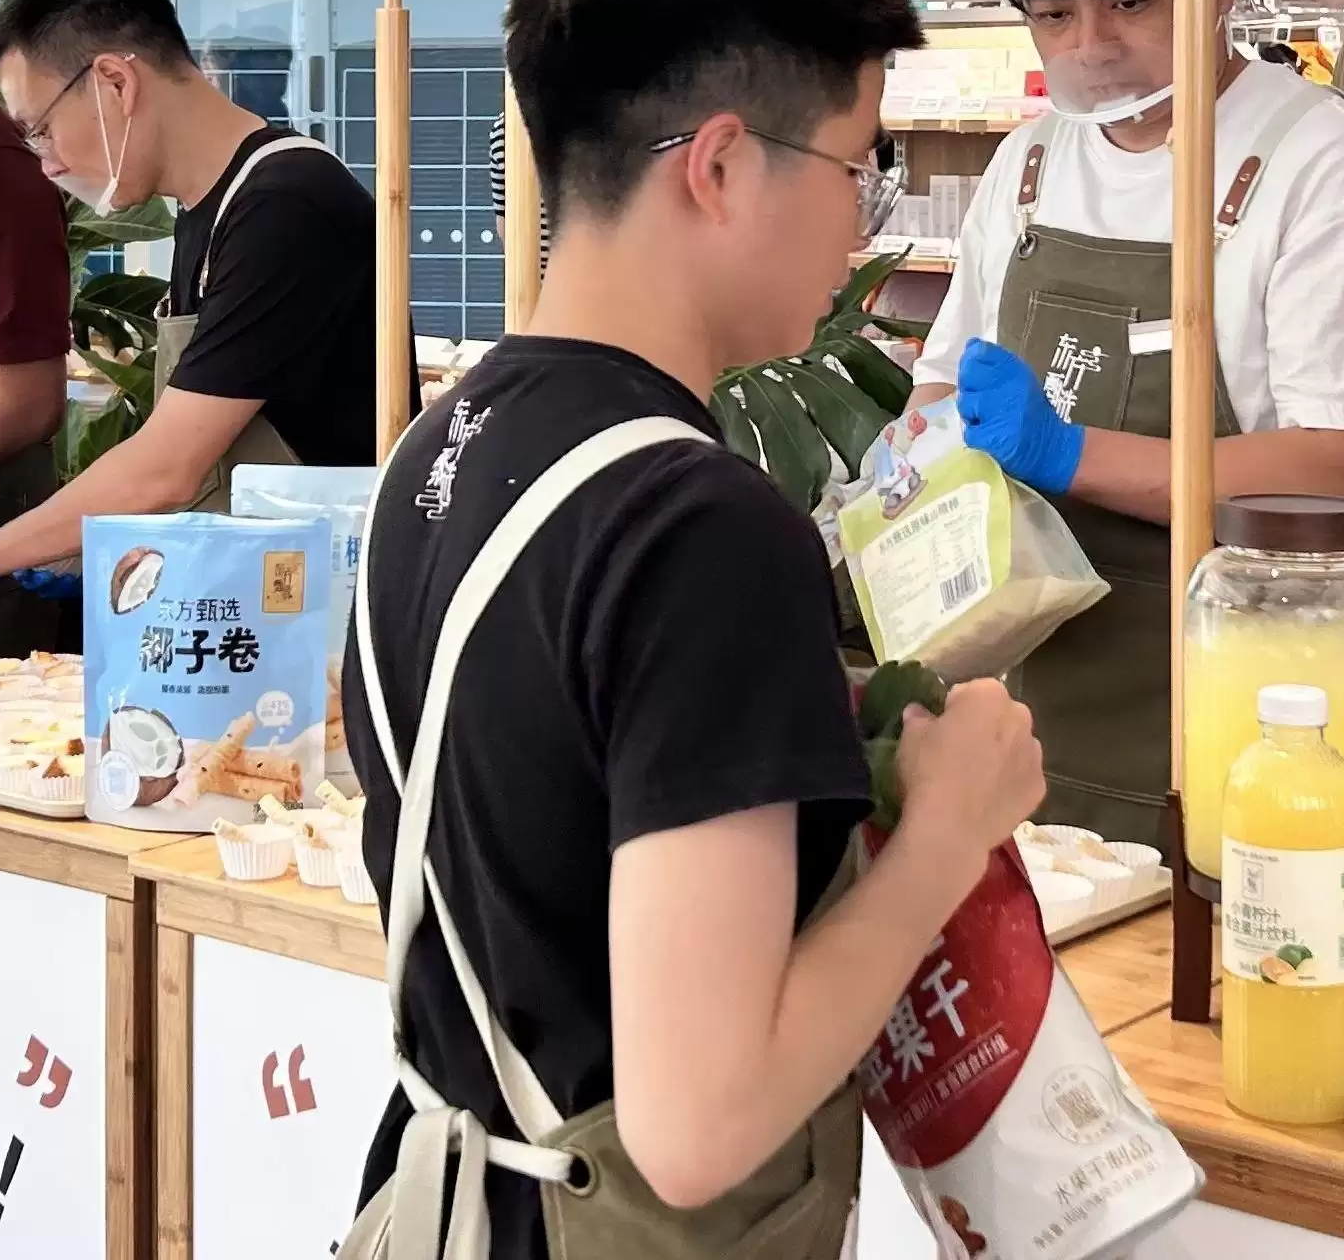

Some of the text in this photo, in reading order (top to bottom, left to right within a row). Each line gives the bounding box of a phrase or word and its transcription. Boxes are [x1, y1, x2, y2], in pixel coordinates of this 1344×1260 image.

[157, 597, 242, 624] 东方甄选
[139, 625, 260, 676] 椰子卷
